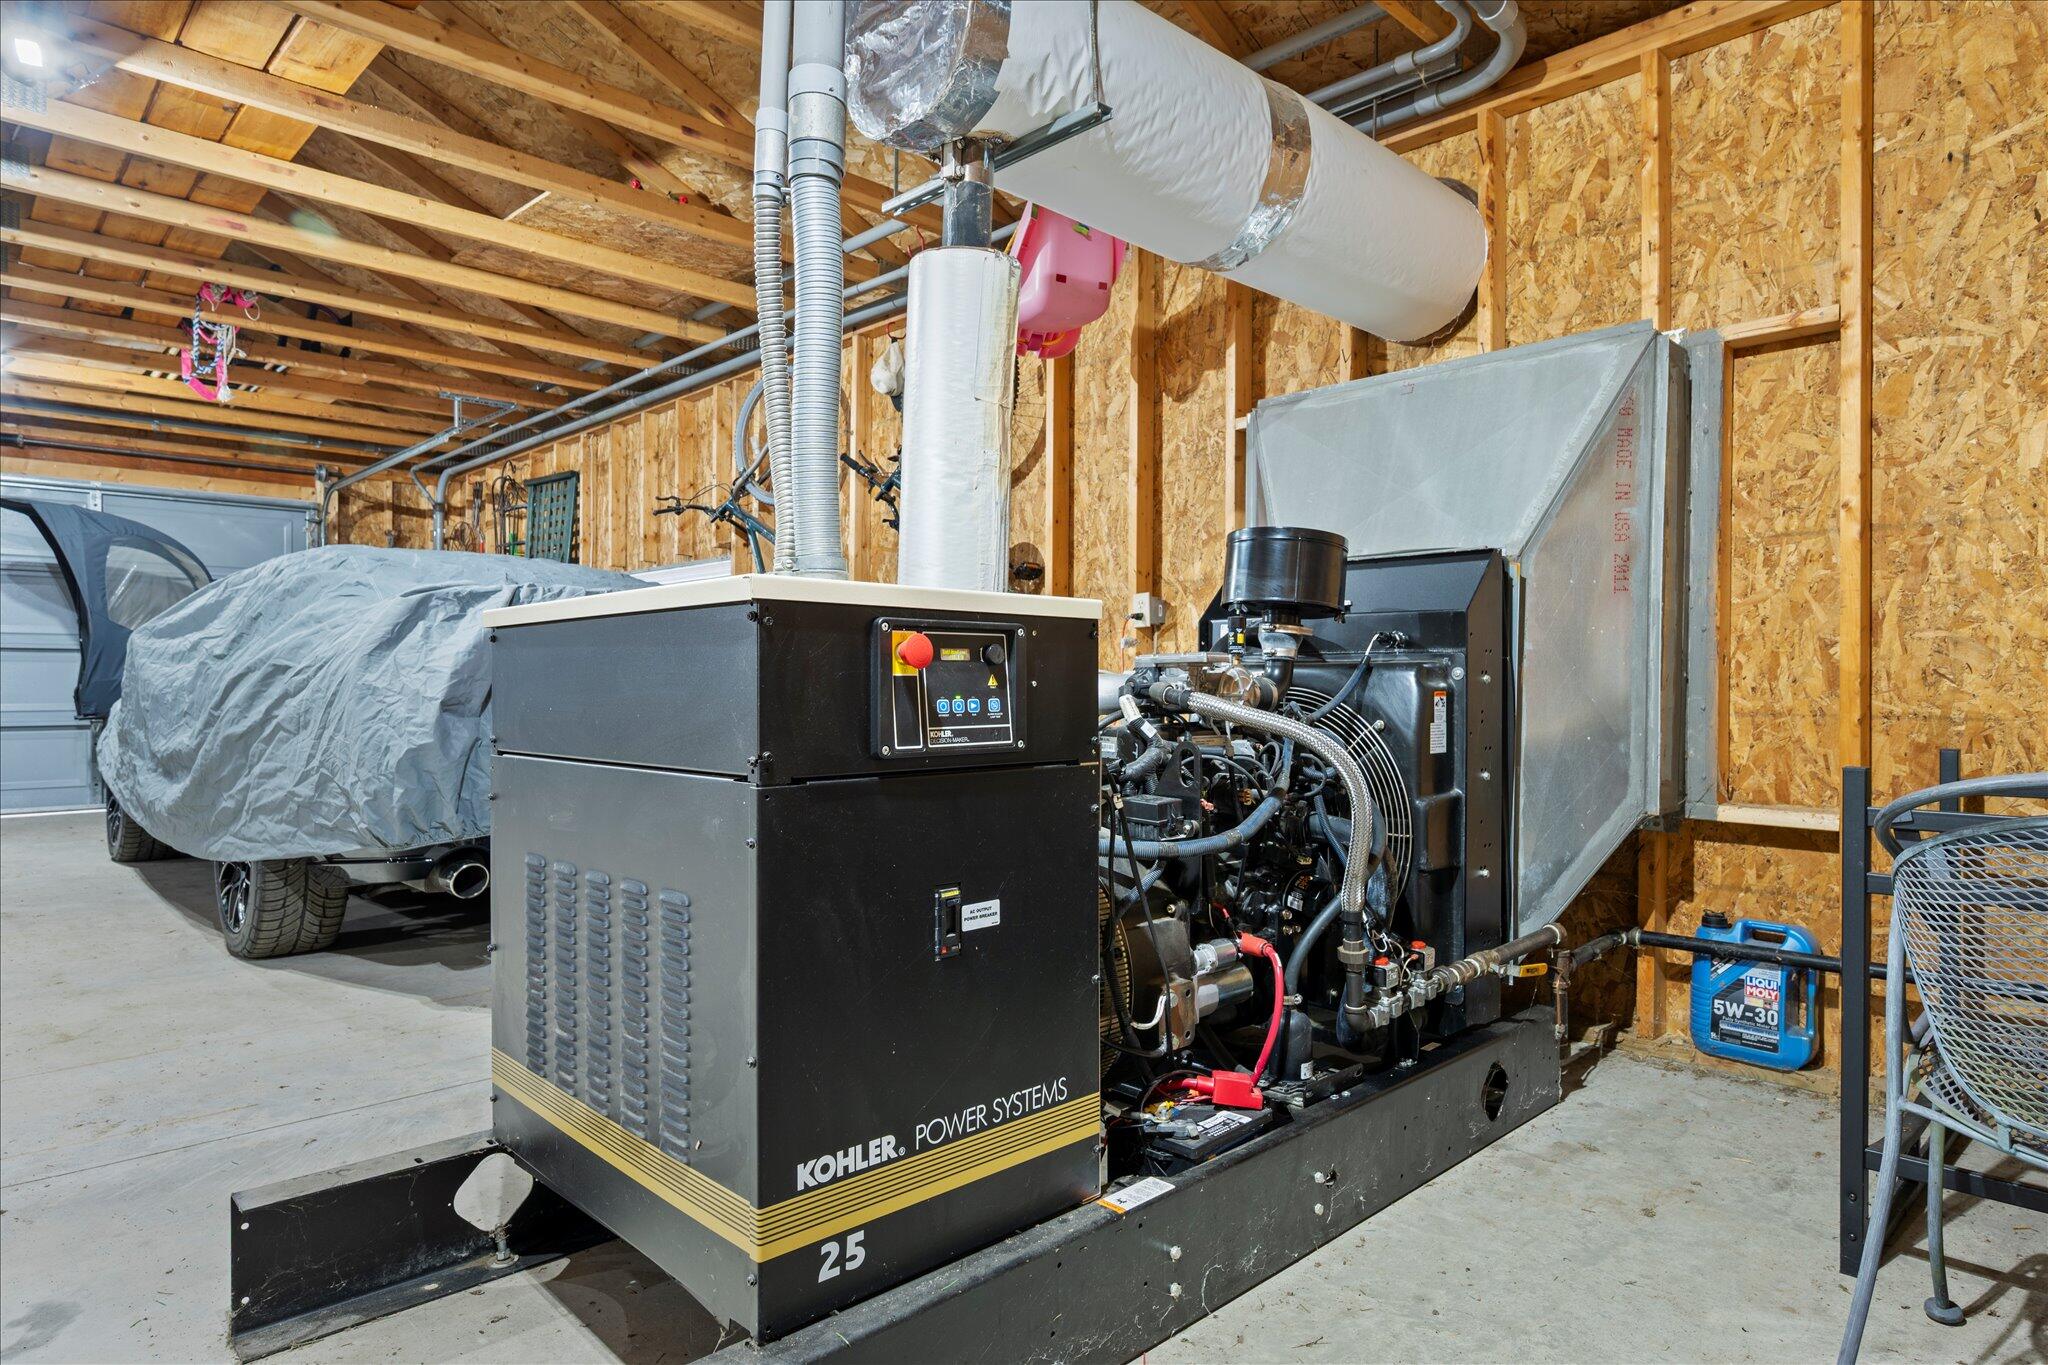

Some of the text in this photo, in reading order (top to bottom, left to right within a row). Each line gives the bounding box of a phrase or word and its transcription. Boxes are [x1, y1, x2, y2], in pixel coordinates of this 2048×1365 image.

[1616, 428, 1633, 469] MADE
[1614, 482, 1631, 501] IN
[1614, 512, 1631, 543] USA
[1612, 553, 1630, 594] 2011
[930, 730, 953, 738] KOHLER
[1746, 976, 1778, 990] LIQUI
[1746, 986, 1779, 1000] MOLY
[1713, 999, 1779, 1026] 5W-30
[915, 1103, 987, 1151] POWER
[992, 1076, 1068, 1123] SYSTEMS
[817, 1229, 866, 1284] 25
